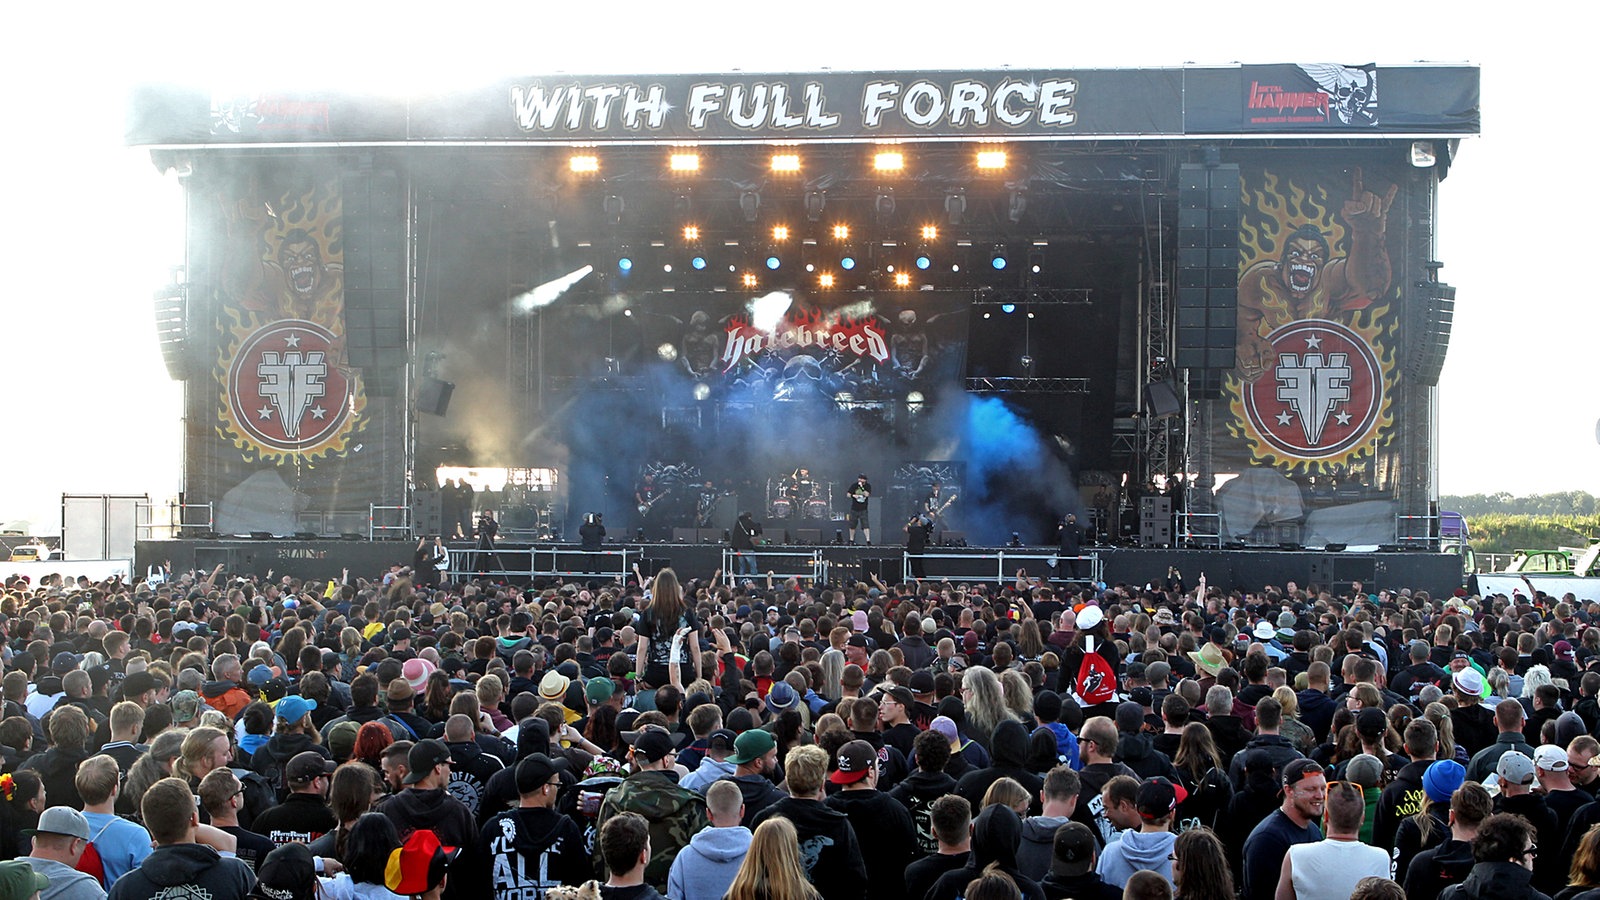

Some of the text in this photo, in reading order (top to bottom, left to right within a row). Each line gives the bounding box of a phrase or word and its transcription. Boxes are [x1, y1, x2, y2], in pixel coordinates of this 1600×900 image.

[510, 77, 1080, 131] WITH FULL FORCE
[1248, 81, 1330, 123] HAMMER
[1257, 85, 1284, 93] METAL
[721, 324, 890, 375] hatebreed
[452, 771, 463, 781] OF
[464, 773, 475, 783] IT
[493, 852, 562, 889] ALL
